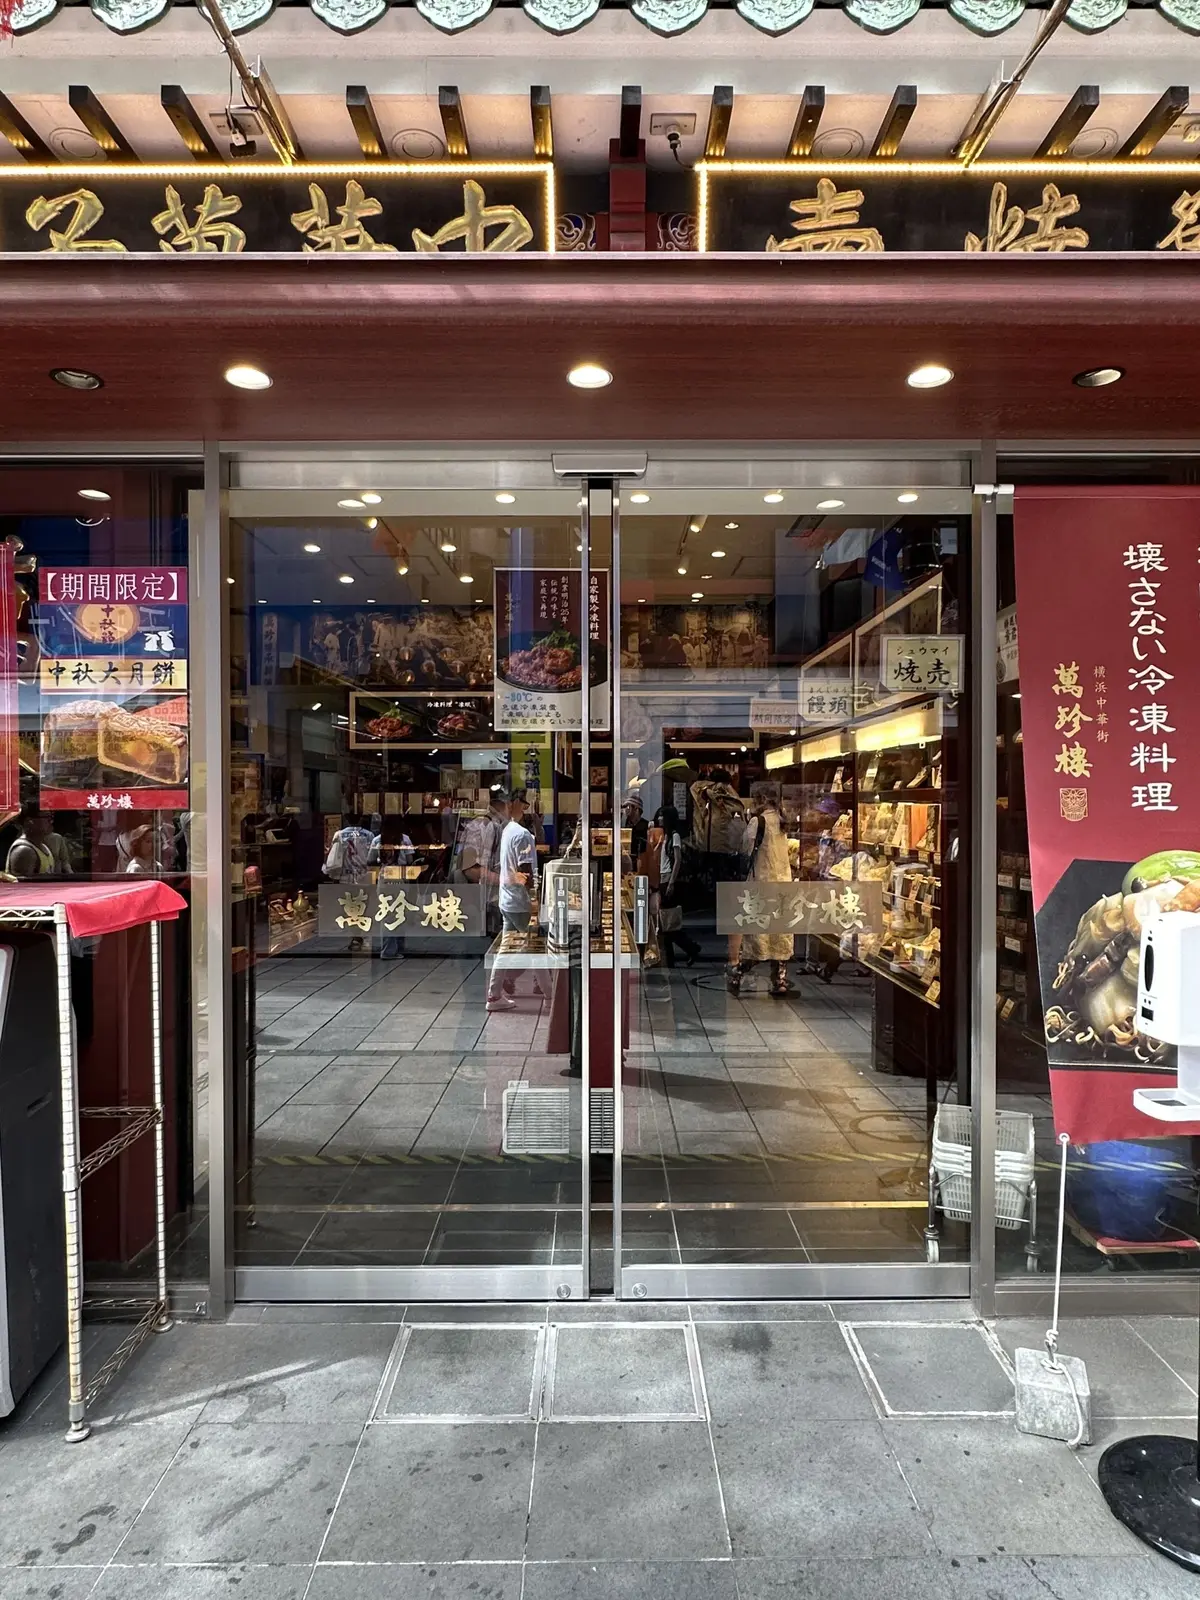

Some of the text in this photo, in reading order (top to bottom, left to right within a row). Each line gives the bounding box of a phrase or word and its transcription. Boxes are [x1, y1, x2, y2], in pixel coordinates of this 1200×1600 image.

[46, 572, 179, 601] 【期間限定】
[589, 575, 600, 640] 自家製冷凍料理
[897, 646, 949, 656] シュウマイ
[48, 661, 176, 687] 中秋大月餅
[893, 658, 950, 686] 焼売
[1123, 541, 1178, 812] 壊さない冷凍料理
[807, 695, 849, 715] 饅頭
[1052, 661, 1093, 778] 萬珍樓
[1093, 665, 1109, 743] 横浜中華街
[86, 793, 134, 809] 萬珍樓
[335, 889, 468, 932] 萬珍樓
[734, 886, 867, 930] 萬珍樓
